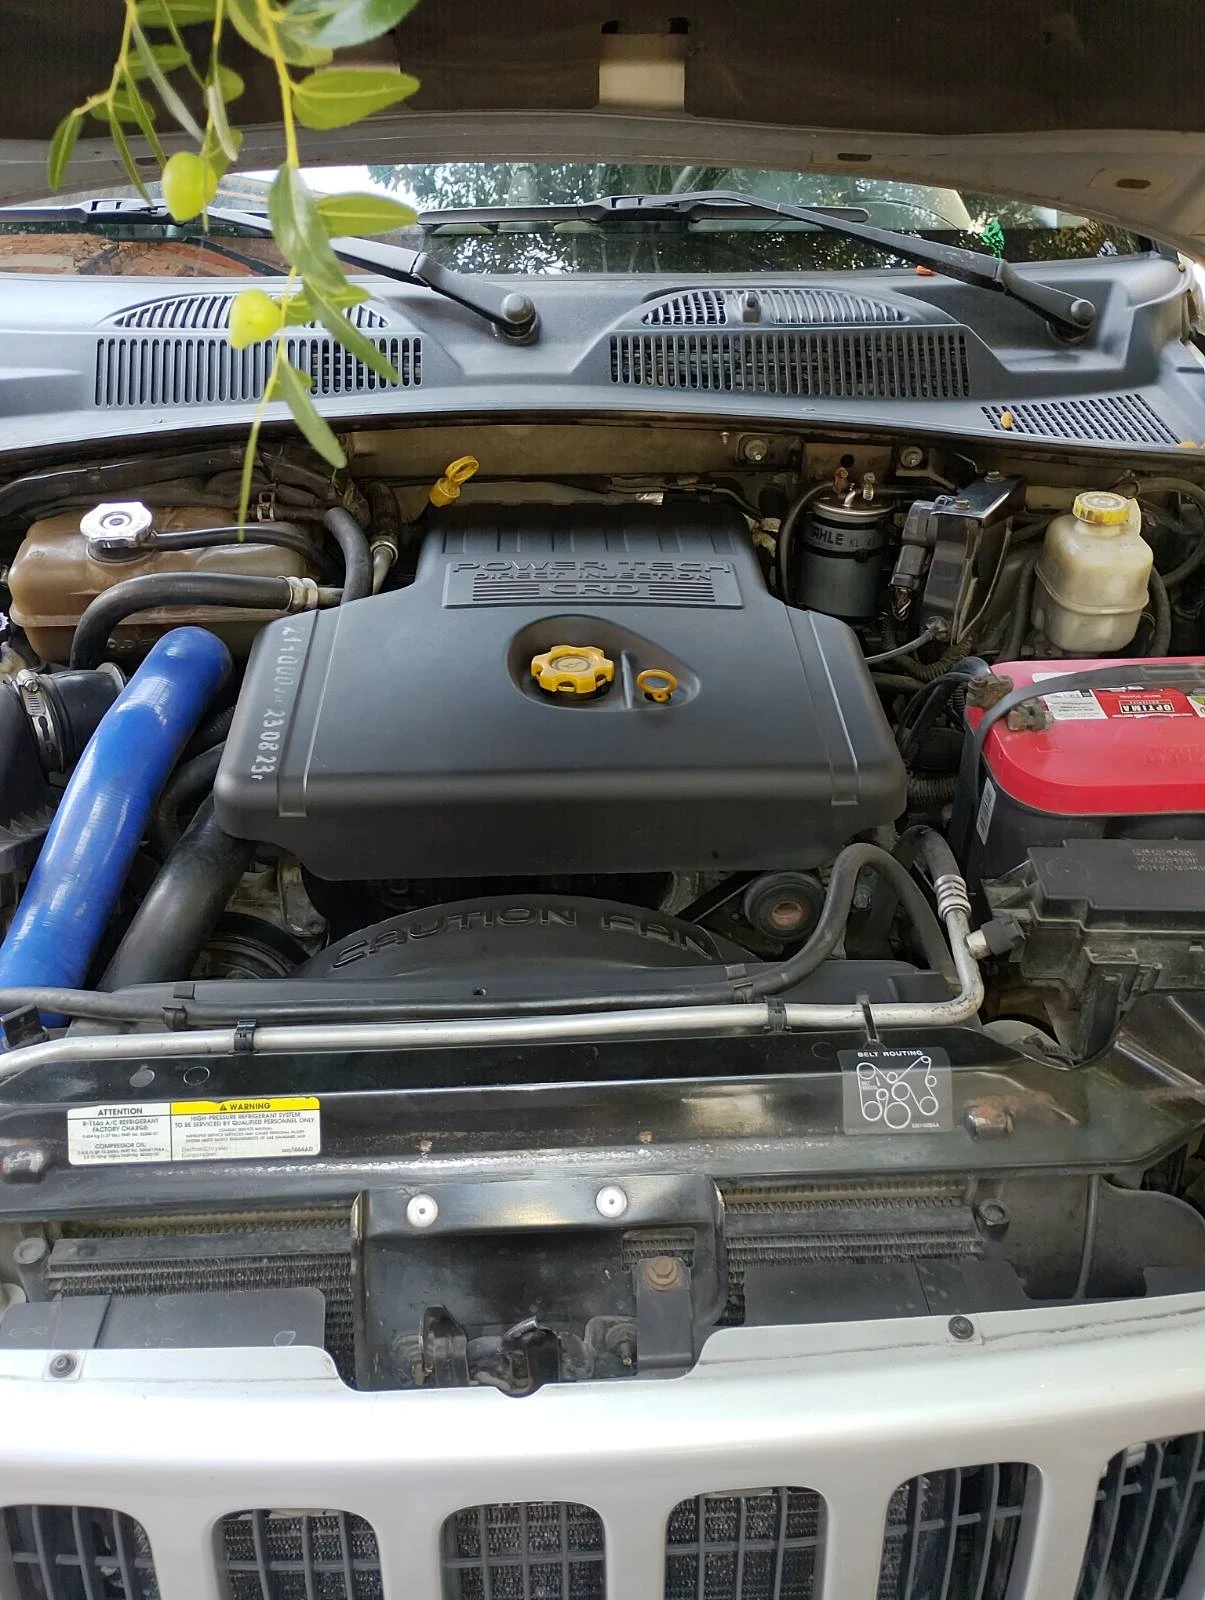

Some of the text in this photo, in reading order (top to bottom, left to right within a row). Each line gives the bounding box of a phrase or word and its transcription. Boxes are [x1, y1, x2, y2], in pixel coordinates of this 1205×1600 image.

[453, 560, 732, 574] POWER TECH
[473, 572, 713, 581] DIRECT INJECTION
[548, 584, 641, 596] CRD
[1122, 704, 1172, 712] OPTIMA
[331, 907, 713, 970] CAUTION FAN
[229, 1102, 271, 1111] WARNING
[97, 1107, 143, 1117] ATTENTION
[238, 1112, 278, 1121] REFRIGERANT
[278, 1111, 301, 1119] SYSTEM
[119, 1118, 159, 1126] REFRIGERANT
[193, 1120, 221, 1128] SERVICED
